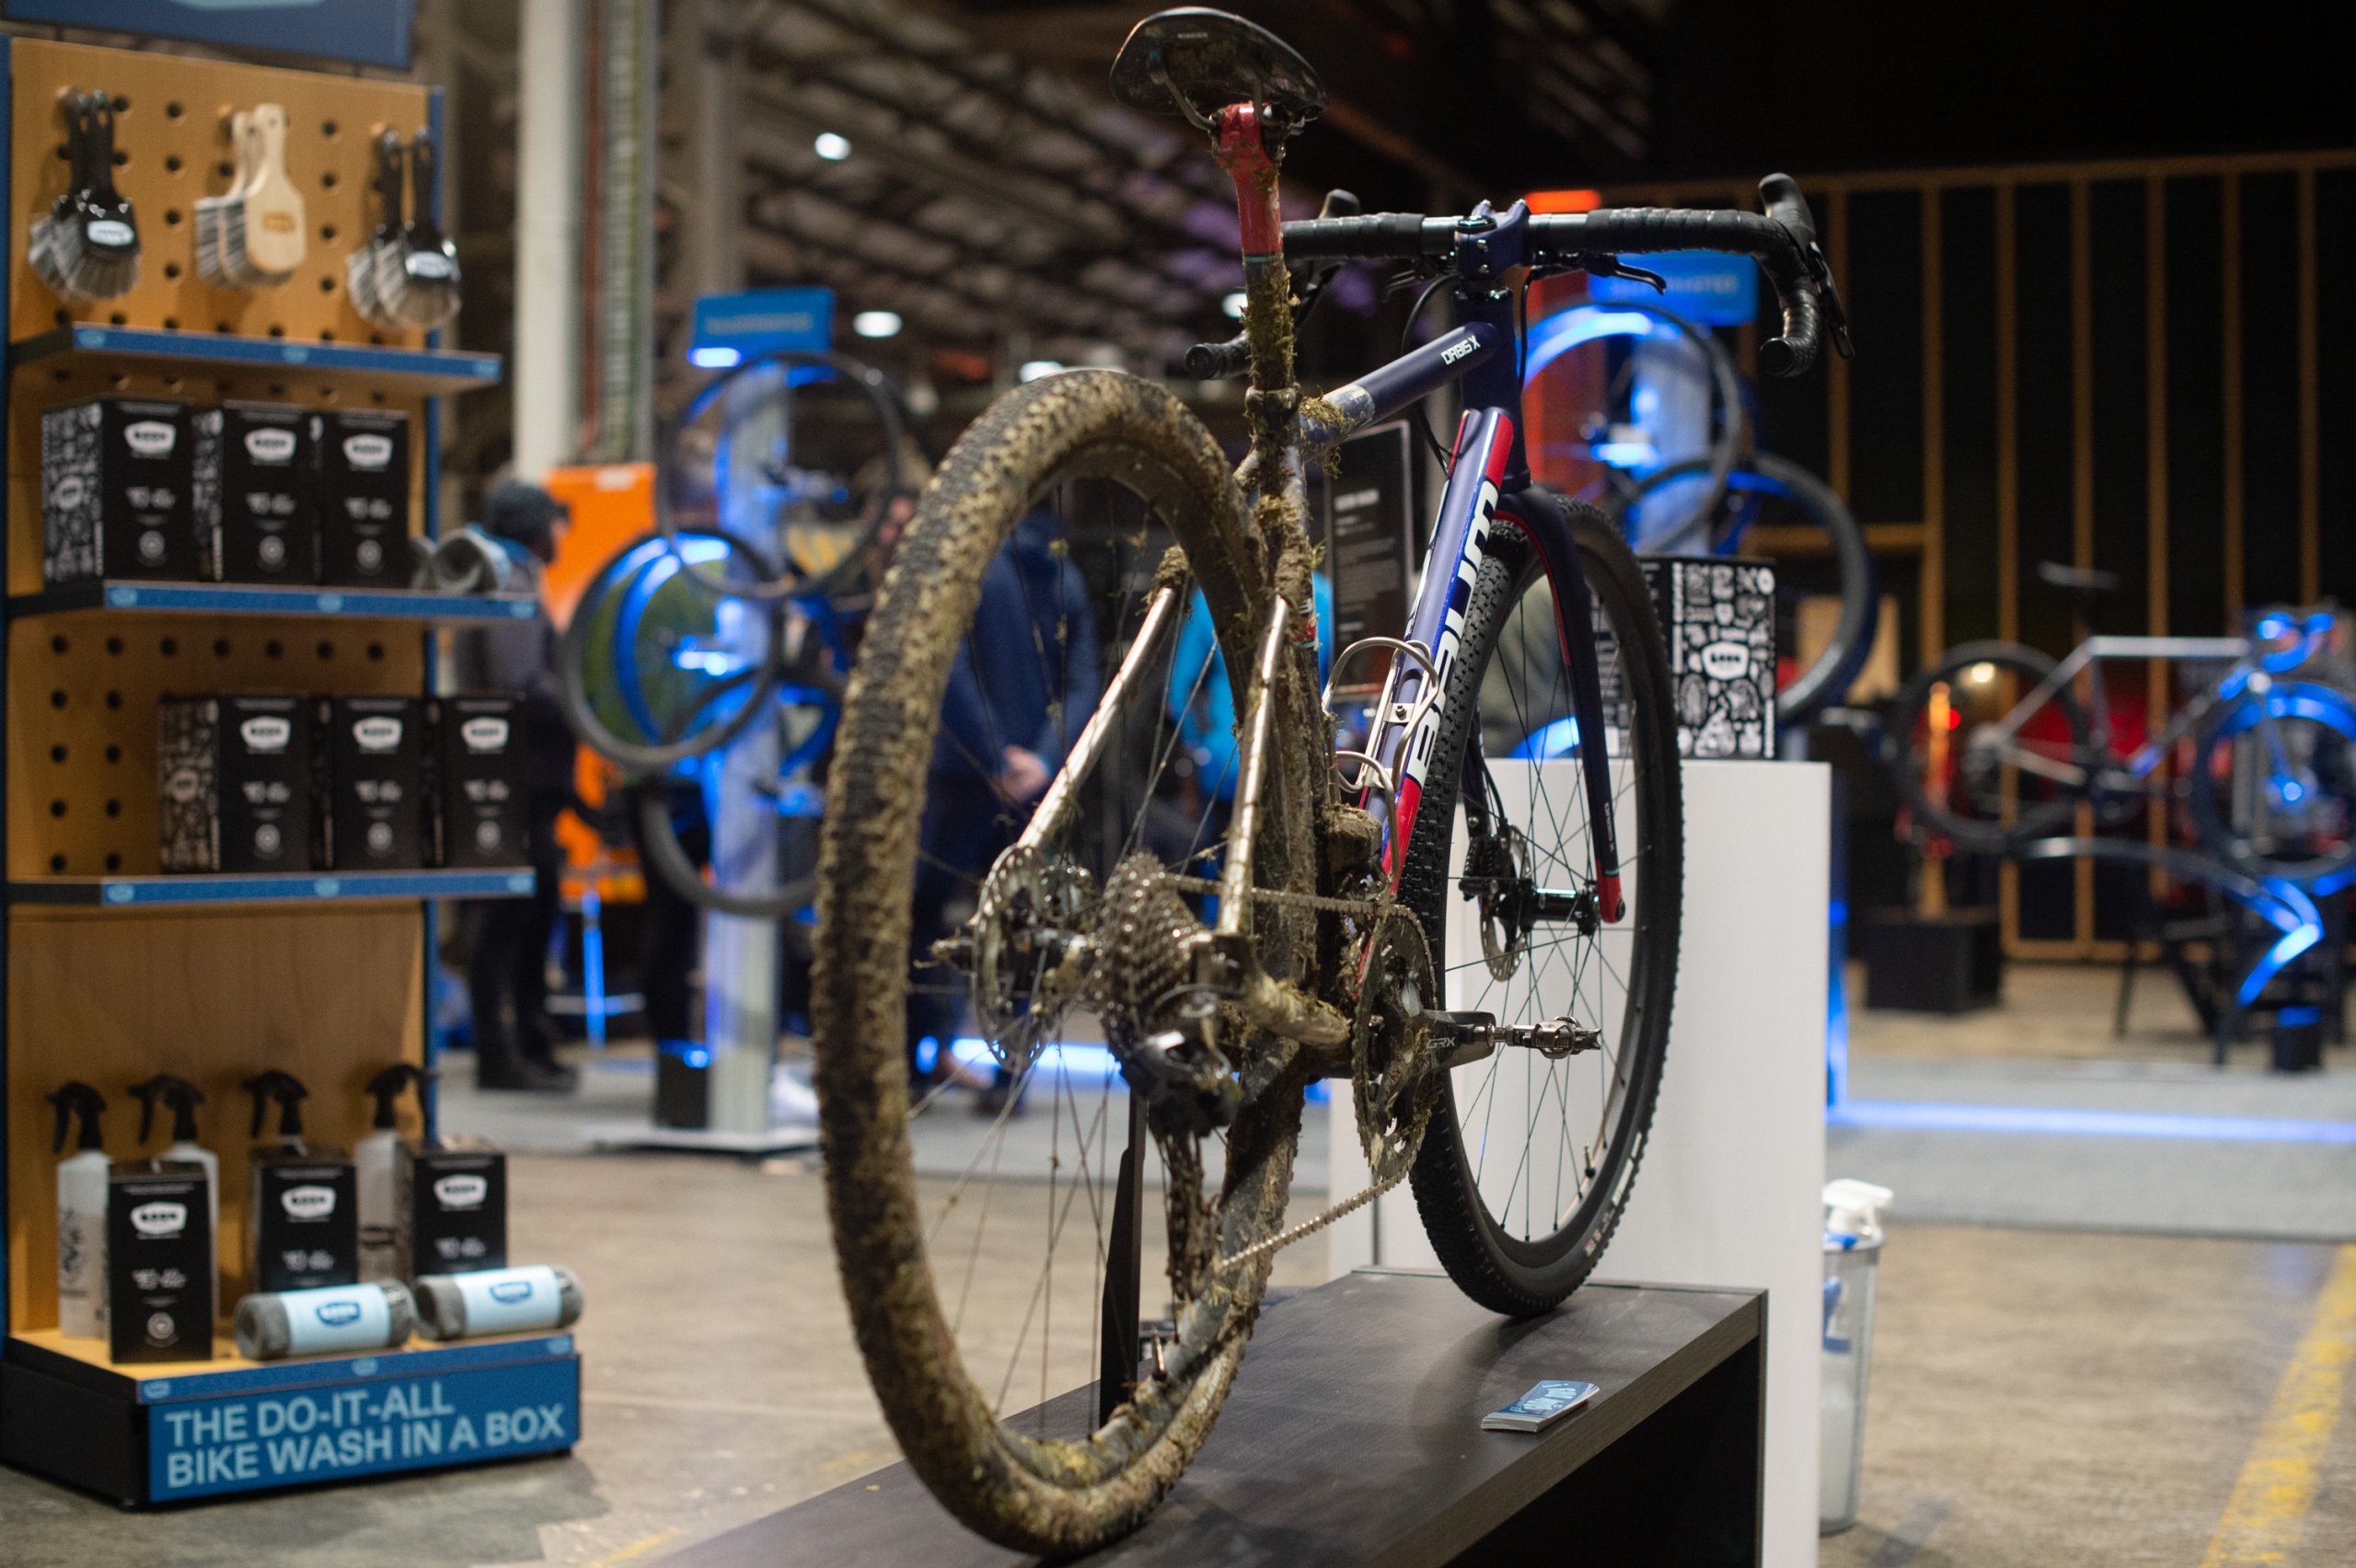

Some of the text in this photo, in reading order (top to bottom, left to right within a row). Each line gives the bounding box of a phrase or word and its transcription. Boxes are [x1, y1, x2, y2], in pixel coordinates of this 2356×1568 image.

[1440, 335, 1481, 365] ORBIS X
[1405, 480, 1498, 783] BAUM
[1426, 1037, 1455, 1049] GRX
[165, 1381, 455, 1448] THE DO-IT-ALL
[167, 1403, 565, 1488] BIKE WASH IN A BOX
